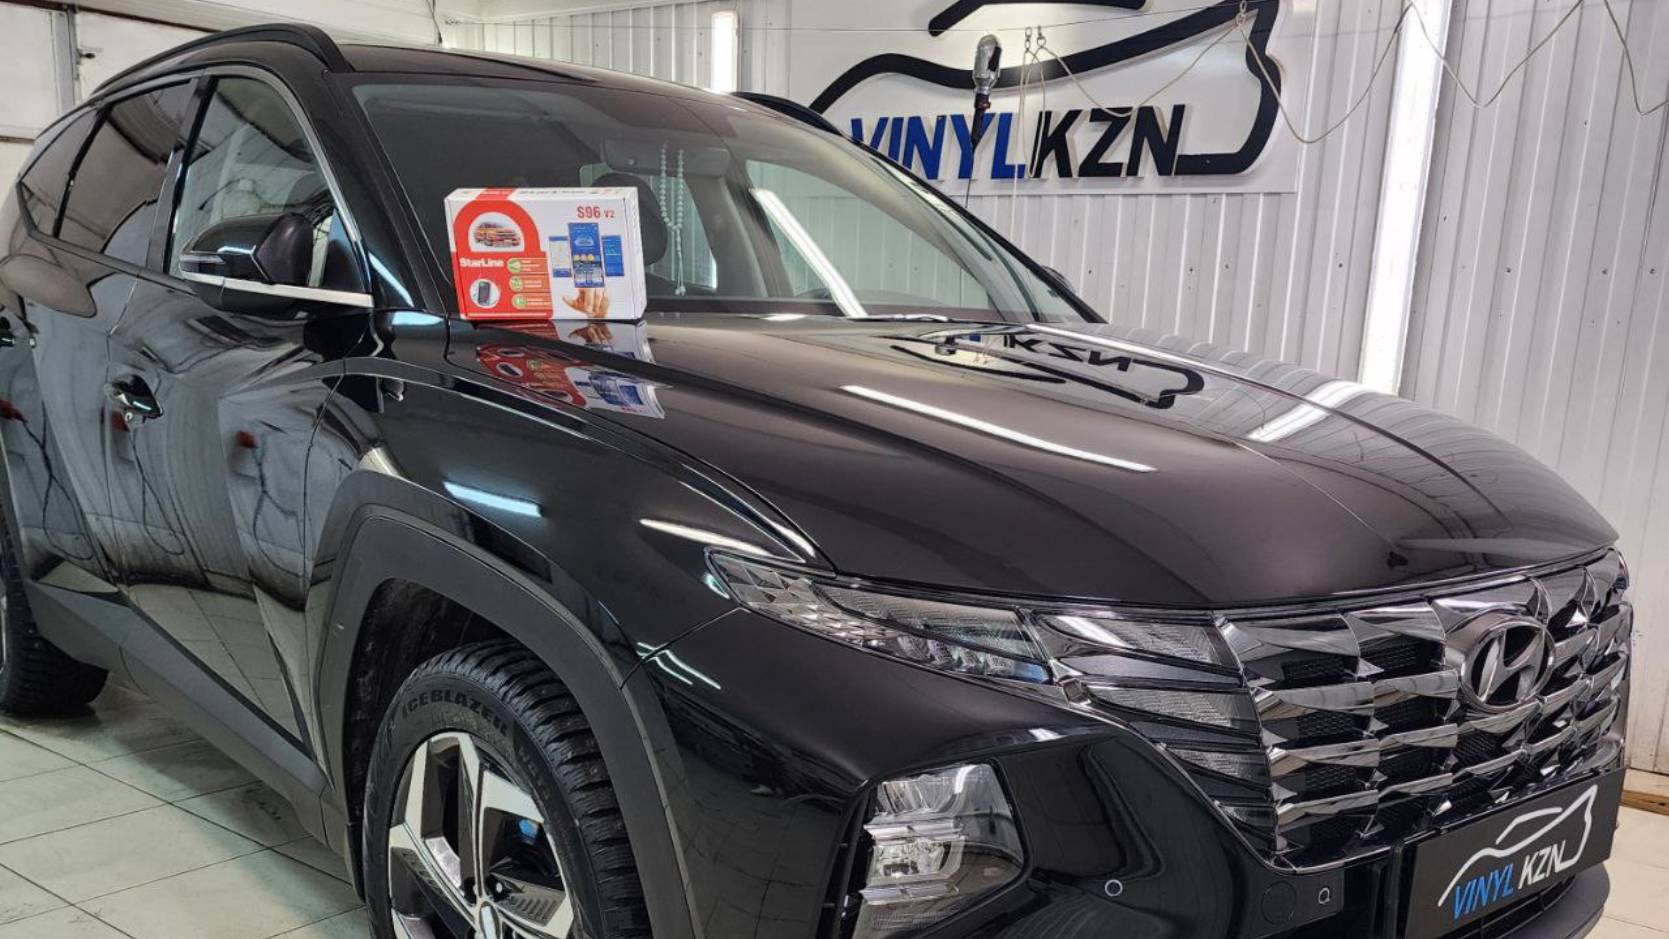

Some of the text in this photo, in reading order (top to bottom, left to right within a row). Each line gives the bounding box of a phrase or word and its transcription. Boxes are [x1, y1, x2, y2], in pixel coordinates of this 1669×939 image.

[1028, 104, 1186, 179] KZN
[577, 206, 601, 219] S96
[459, 257, 504, 268] StarLine
[402, 689, 508, 737] ICEBLAZER
[1453, 839, 1567, 920] VINYL KZN
